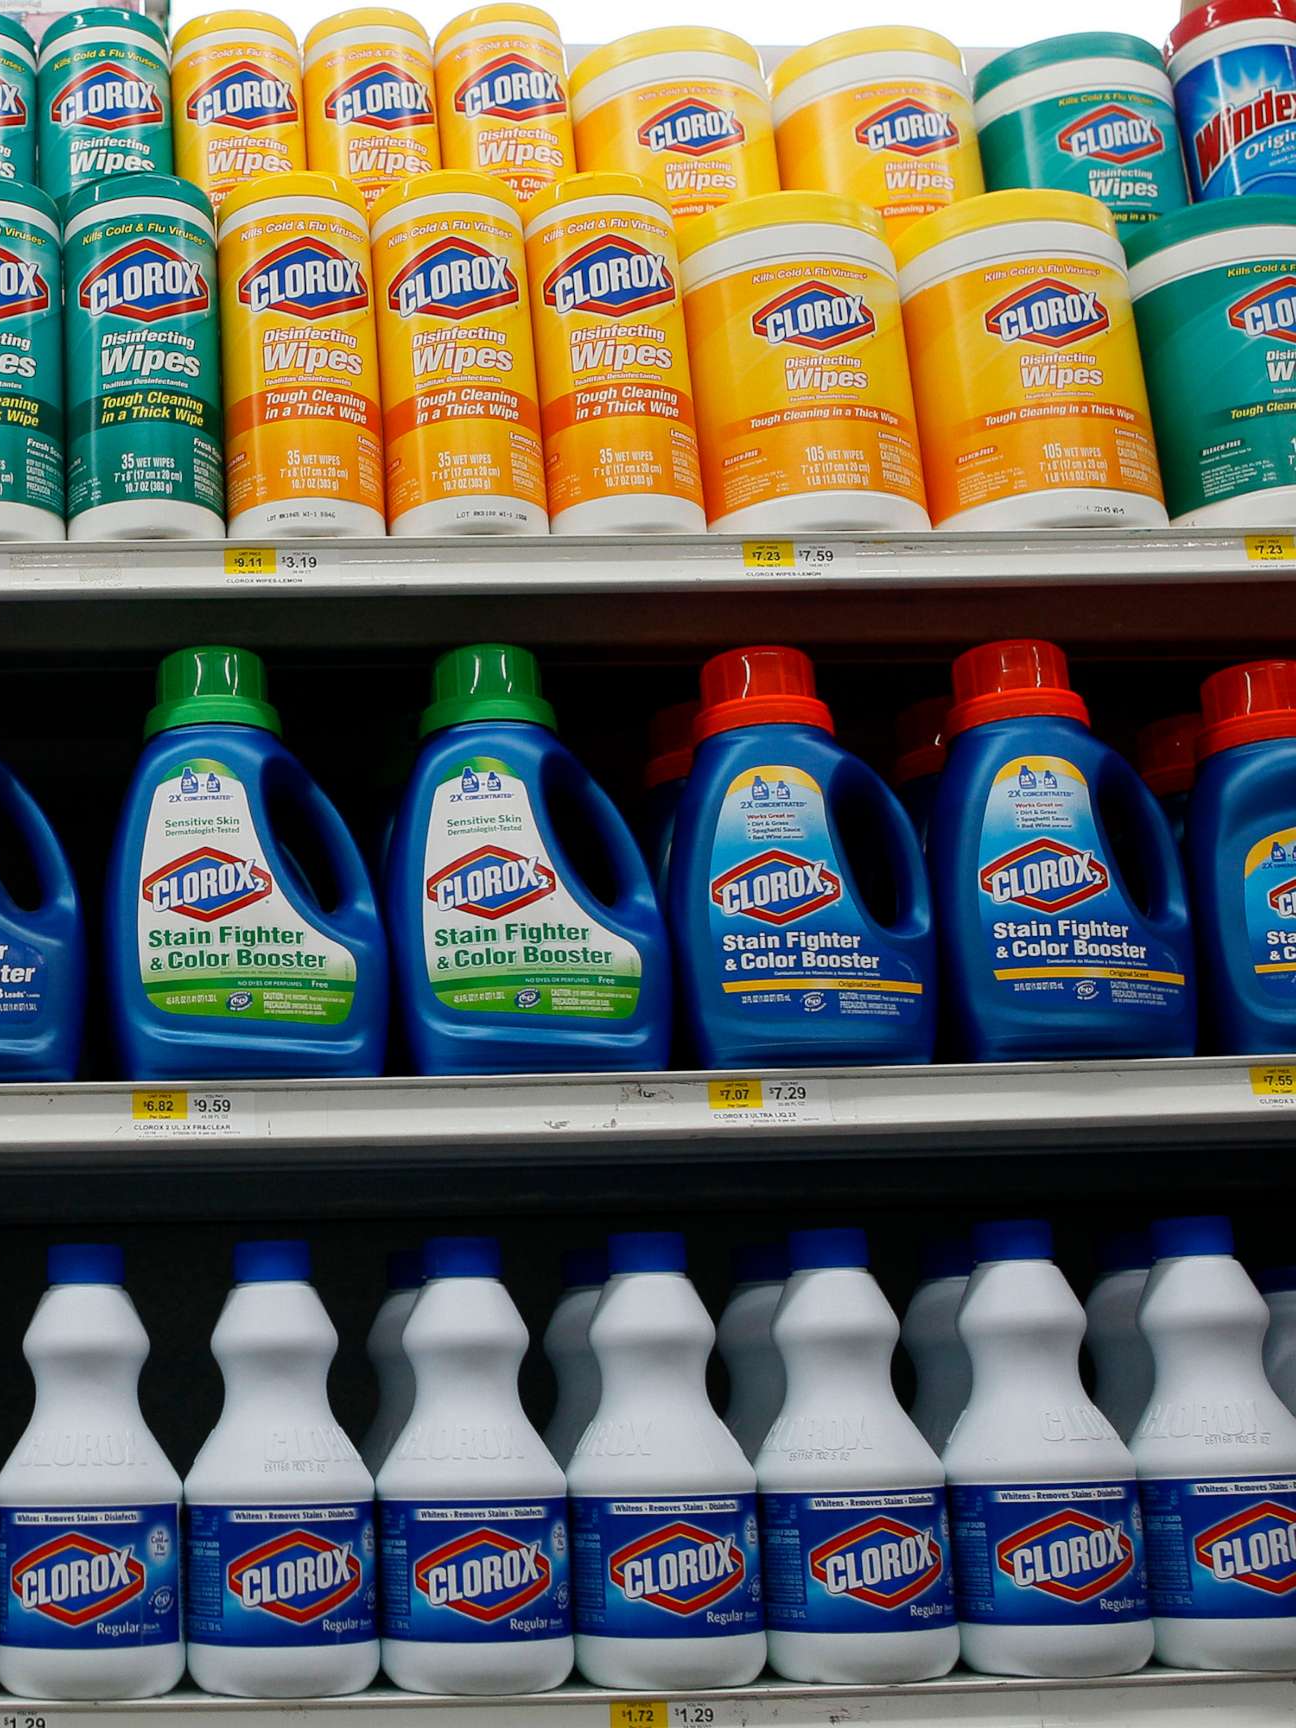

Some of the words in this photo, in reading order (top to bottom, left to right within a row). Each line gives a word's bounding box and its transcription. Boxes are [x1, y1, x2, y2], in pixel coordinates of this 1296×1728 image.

[60, 82, 156, 130] CLOROX
[194, 79, 290, 129] CLOROX
[333, 79, 430, 129] CLOROX
[464, 70, 562, 118] CLOROX
[648, 110, 739, 152] CLOROX
[865, 108, 955, 151] CLOROX
[1071, 119, 1155, 157] CLOROX
[1194, 86, 1296, 190] Winde
[90, 260, 201, 317] CLOROX
[250, 258, 361, 312] CLOROX
[399, 256, 509, 318] CLOROX
[555, 255, 666, 313] CLOROX
[264, 327, 357, 347] Disinfecting
[766, 295, 865, 344] CLOROX
[1000, 292, 1099, 342] CLOROX
[264, 342, 363, 376] Wipes
[785, 356, 861, 369] Disinfecting
[785, 368, 868, 392] Wipes
[7, 411, 39, 427] Wipe
[165, 817, 212, 828] Sensitive
[217, 815, 240, 827] Skin
[165, 827, 240, 837] Dermatologist-Tested
[149, 929, 210, 947] Stain
[219, 927, 304, 946] Fighter
[150, 956, 162, 971] &
[168, 952, 229, 969] Color
[237, 949, 326, 969] Booster
[723, 934, 780, 950] Stain
[786, 932, 861, 950] Fighter
[725, 958, 736, 971] &
[741, 953, 797, 970] Color
[802, 952, 879, 970] Booster
[21, 1546, 134, 1608] CLOROX
[241, 1543, 354, 1607] CLOROX
[428, 1543, 541, 1605] CLOROX
[622, 1537, 737, 1599] CLOROX
[825, 1528, 934, 1595] CLOROX
[1012, 1524, 1123, 1586] CLOROX
[707, 1609, 744, 1626] Regular
